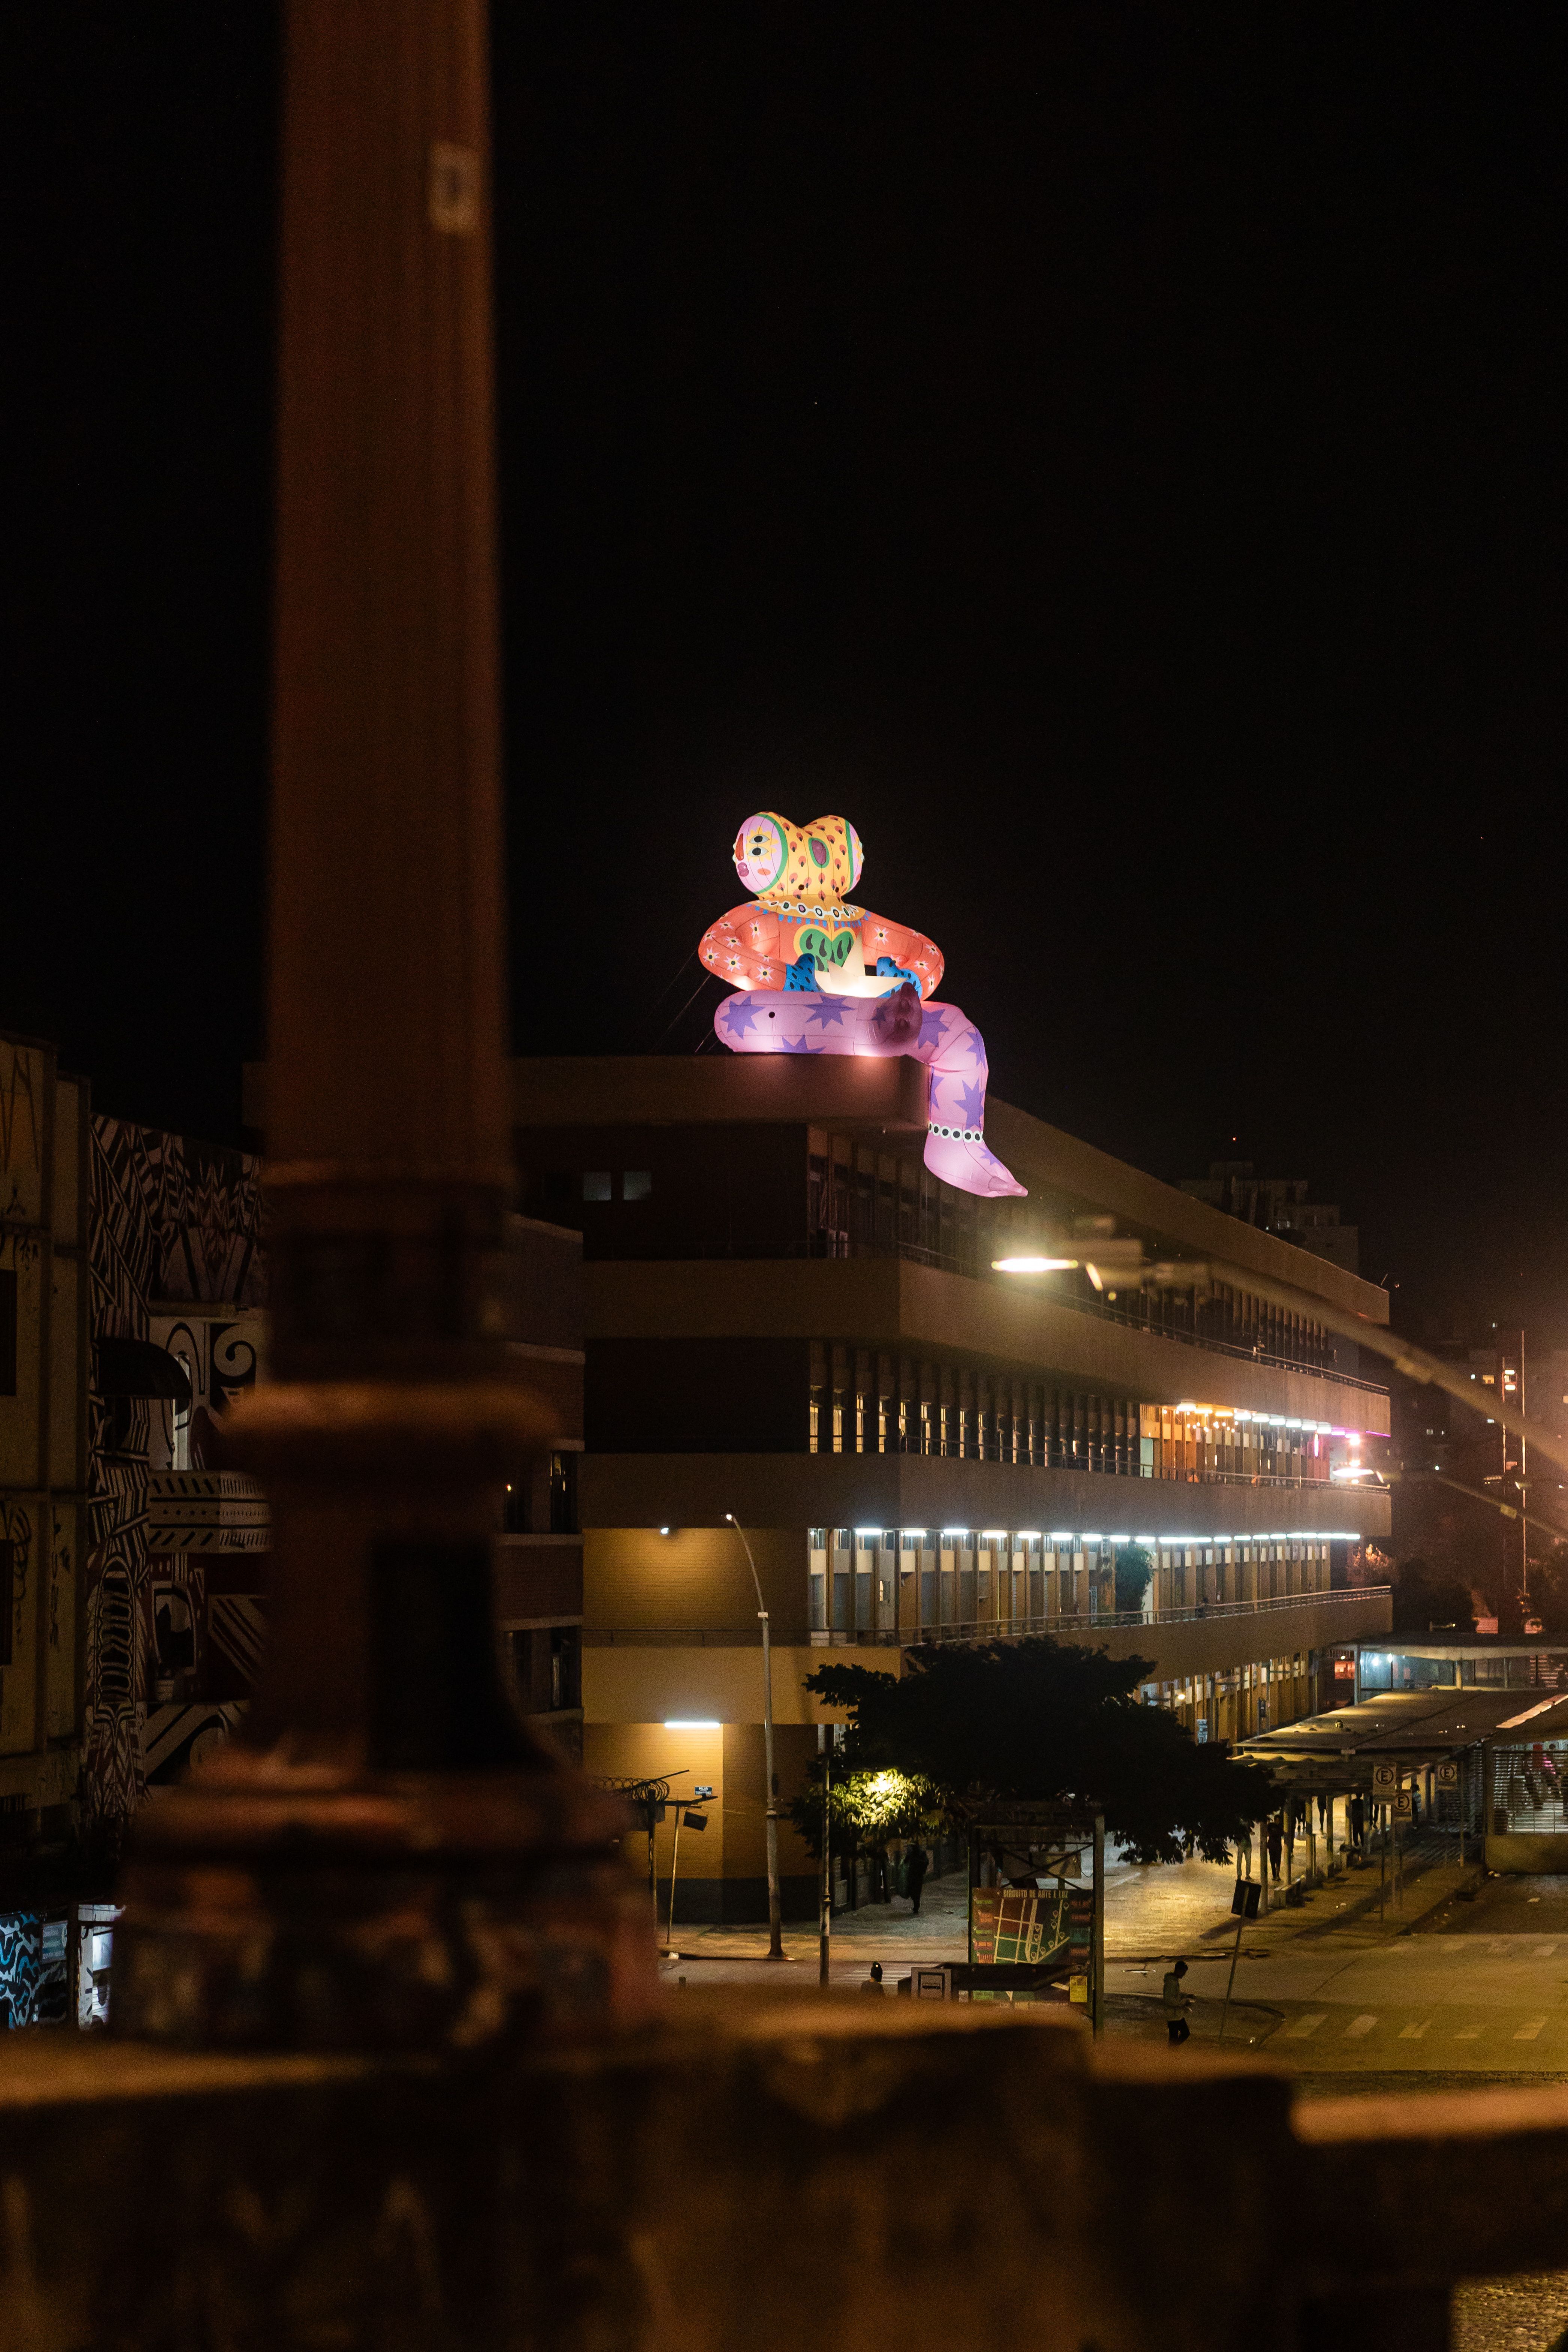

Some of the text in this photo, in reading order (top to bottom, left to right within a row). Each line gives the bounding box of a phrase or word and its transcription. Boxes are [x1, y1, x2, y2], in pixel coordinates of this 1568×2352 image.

[1381, 1770, 1388, 1782] E
[1444, 1768, 1450, 1778] E
[1398, 1797, 1404, 1807] E
[1003, 1889, 1027, 1897] CIRCUITO
[1029, 1890, 1036, 1898] DE
[1038, 1890, 1051, 1898] ARTE
